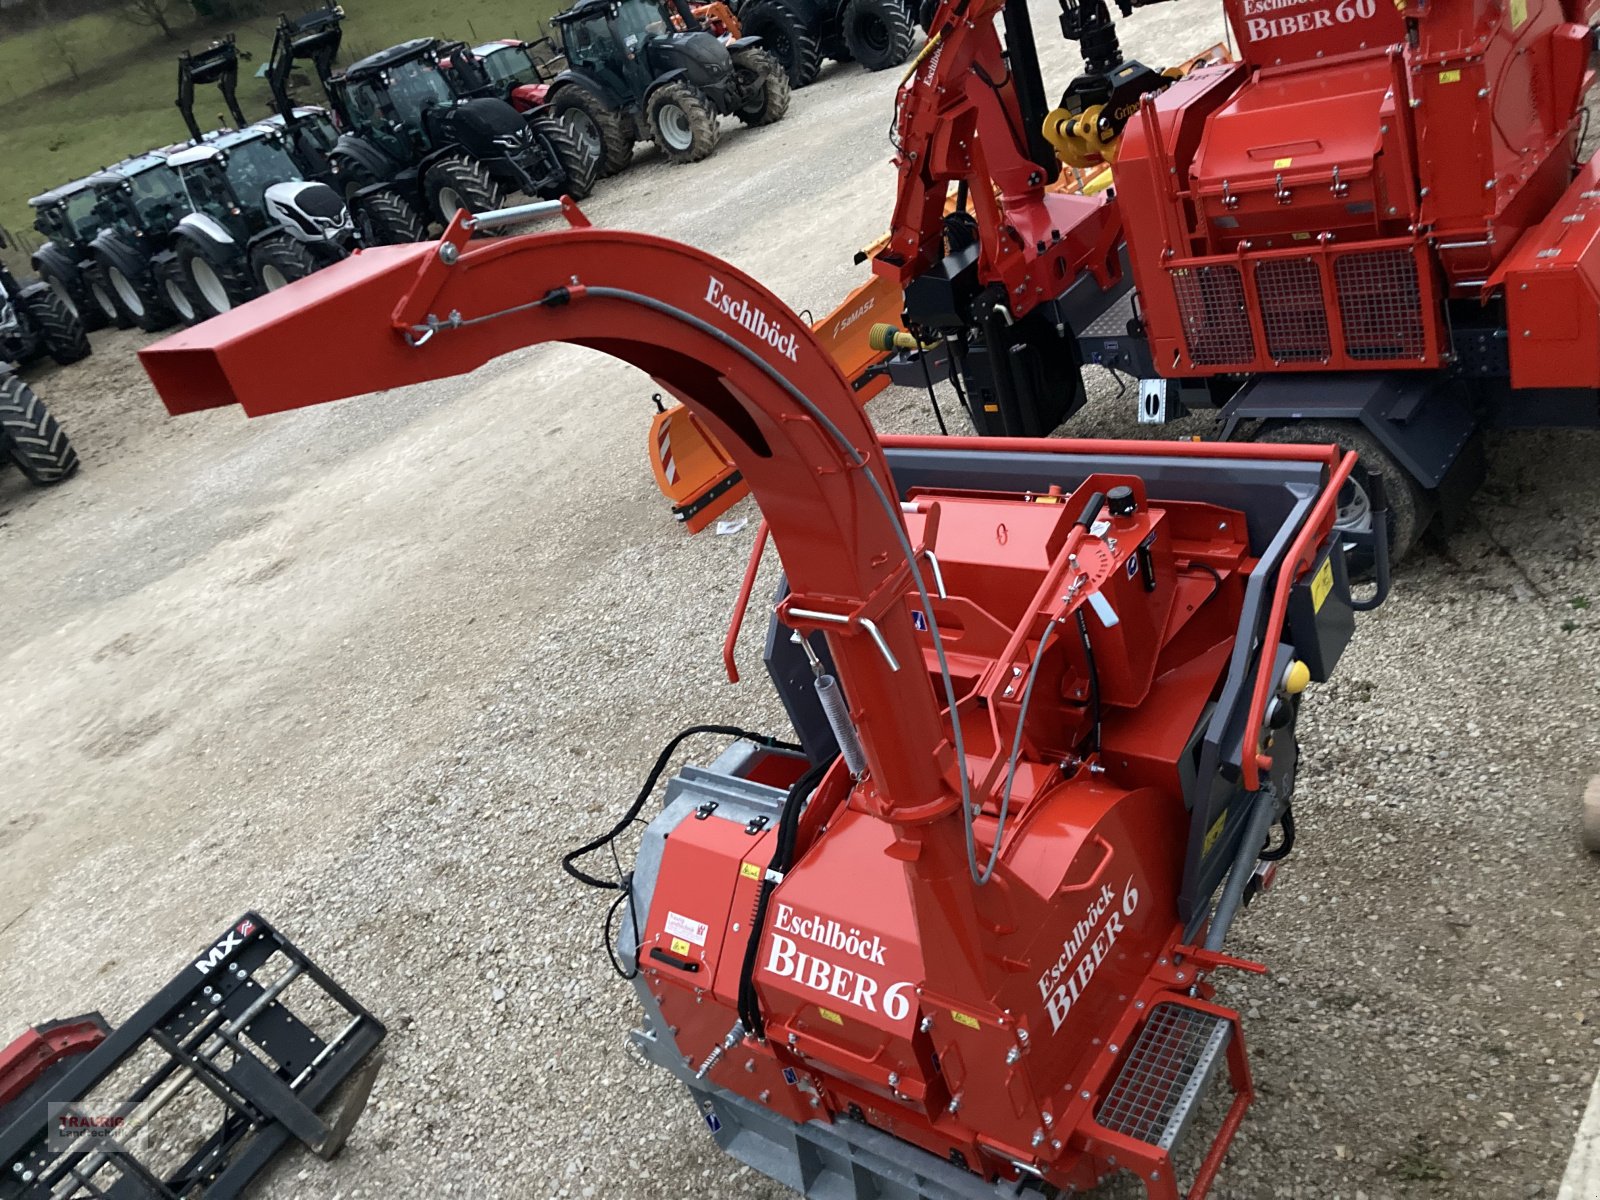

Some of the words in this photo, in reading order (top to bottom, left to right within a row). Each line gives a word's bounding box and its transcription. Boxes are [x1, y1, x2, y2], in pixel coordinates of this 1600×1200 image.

[1245, 9, 1334, 43] BIBER
[1335, 0, 1376, 23] 60
[703, 274, 800, 363] Eschlböck
[194, 930, 243, 975] MX
[764, 932, 878, 1013] BIBER
[882, 981, 914, 1021] 6
[774, 903, 888, 966] Eschlböck
[1037, 882, 1115, 1003] Eschlböck
[1044, 911, 1125, 1037] BIBER
[1122, 873, 1139, 917] 6
